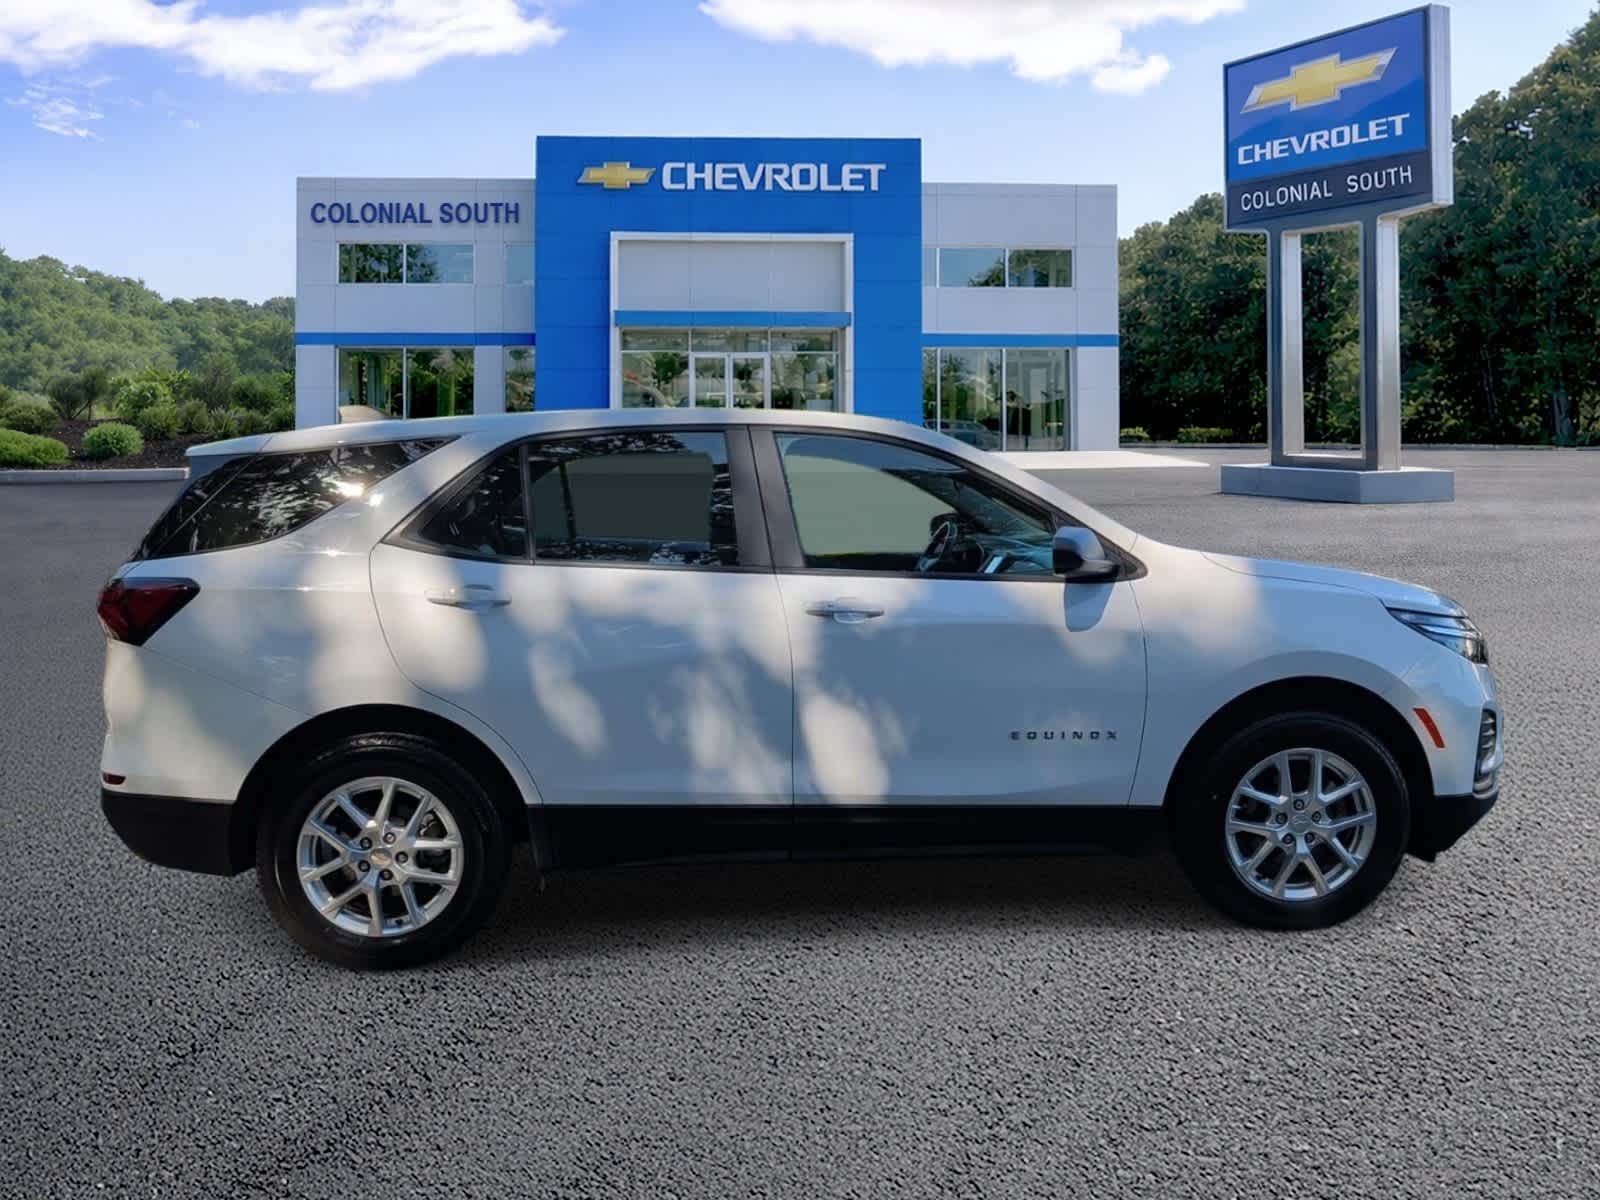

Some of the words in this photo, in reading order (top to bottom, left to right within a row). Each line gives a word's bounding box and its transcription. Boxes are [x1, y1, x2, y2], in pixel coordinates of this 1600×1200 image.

[1237, 113, 1410, 165] CHEVROLET
[661, 162, 886, 191] CHEVROLET
[1240, 179, 1333, 211] COLONIAL
[1346, 165, 1412, 193] SOUTH
[310, 202, 433, 225] COLONIAL
[439, 202, 520, 225] SOUTH
[1009, 730, 1118, 741] EQUINOX
